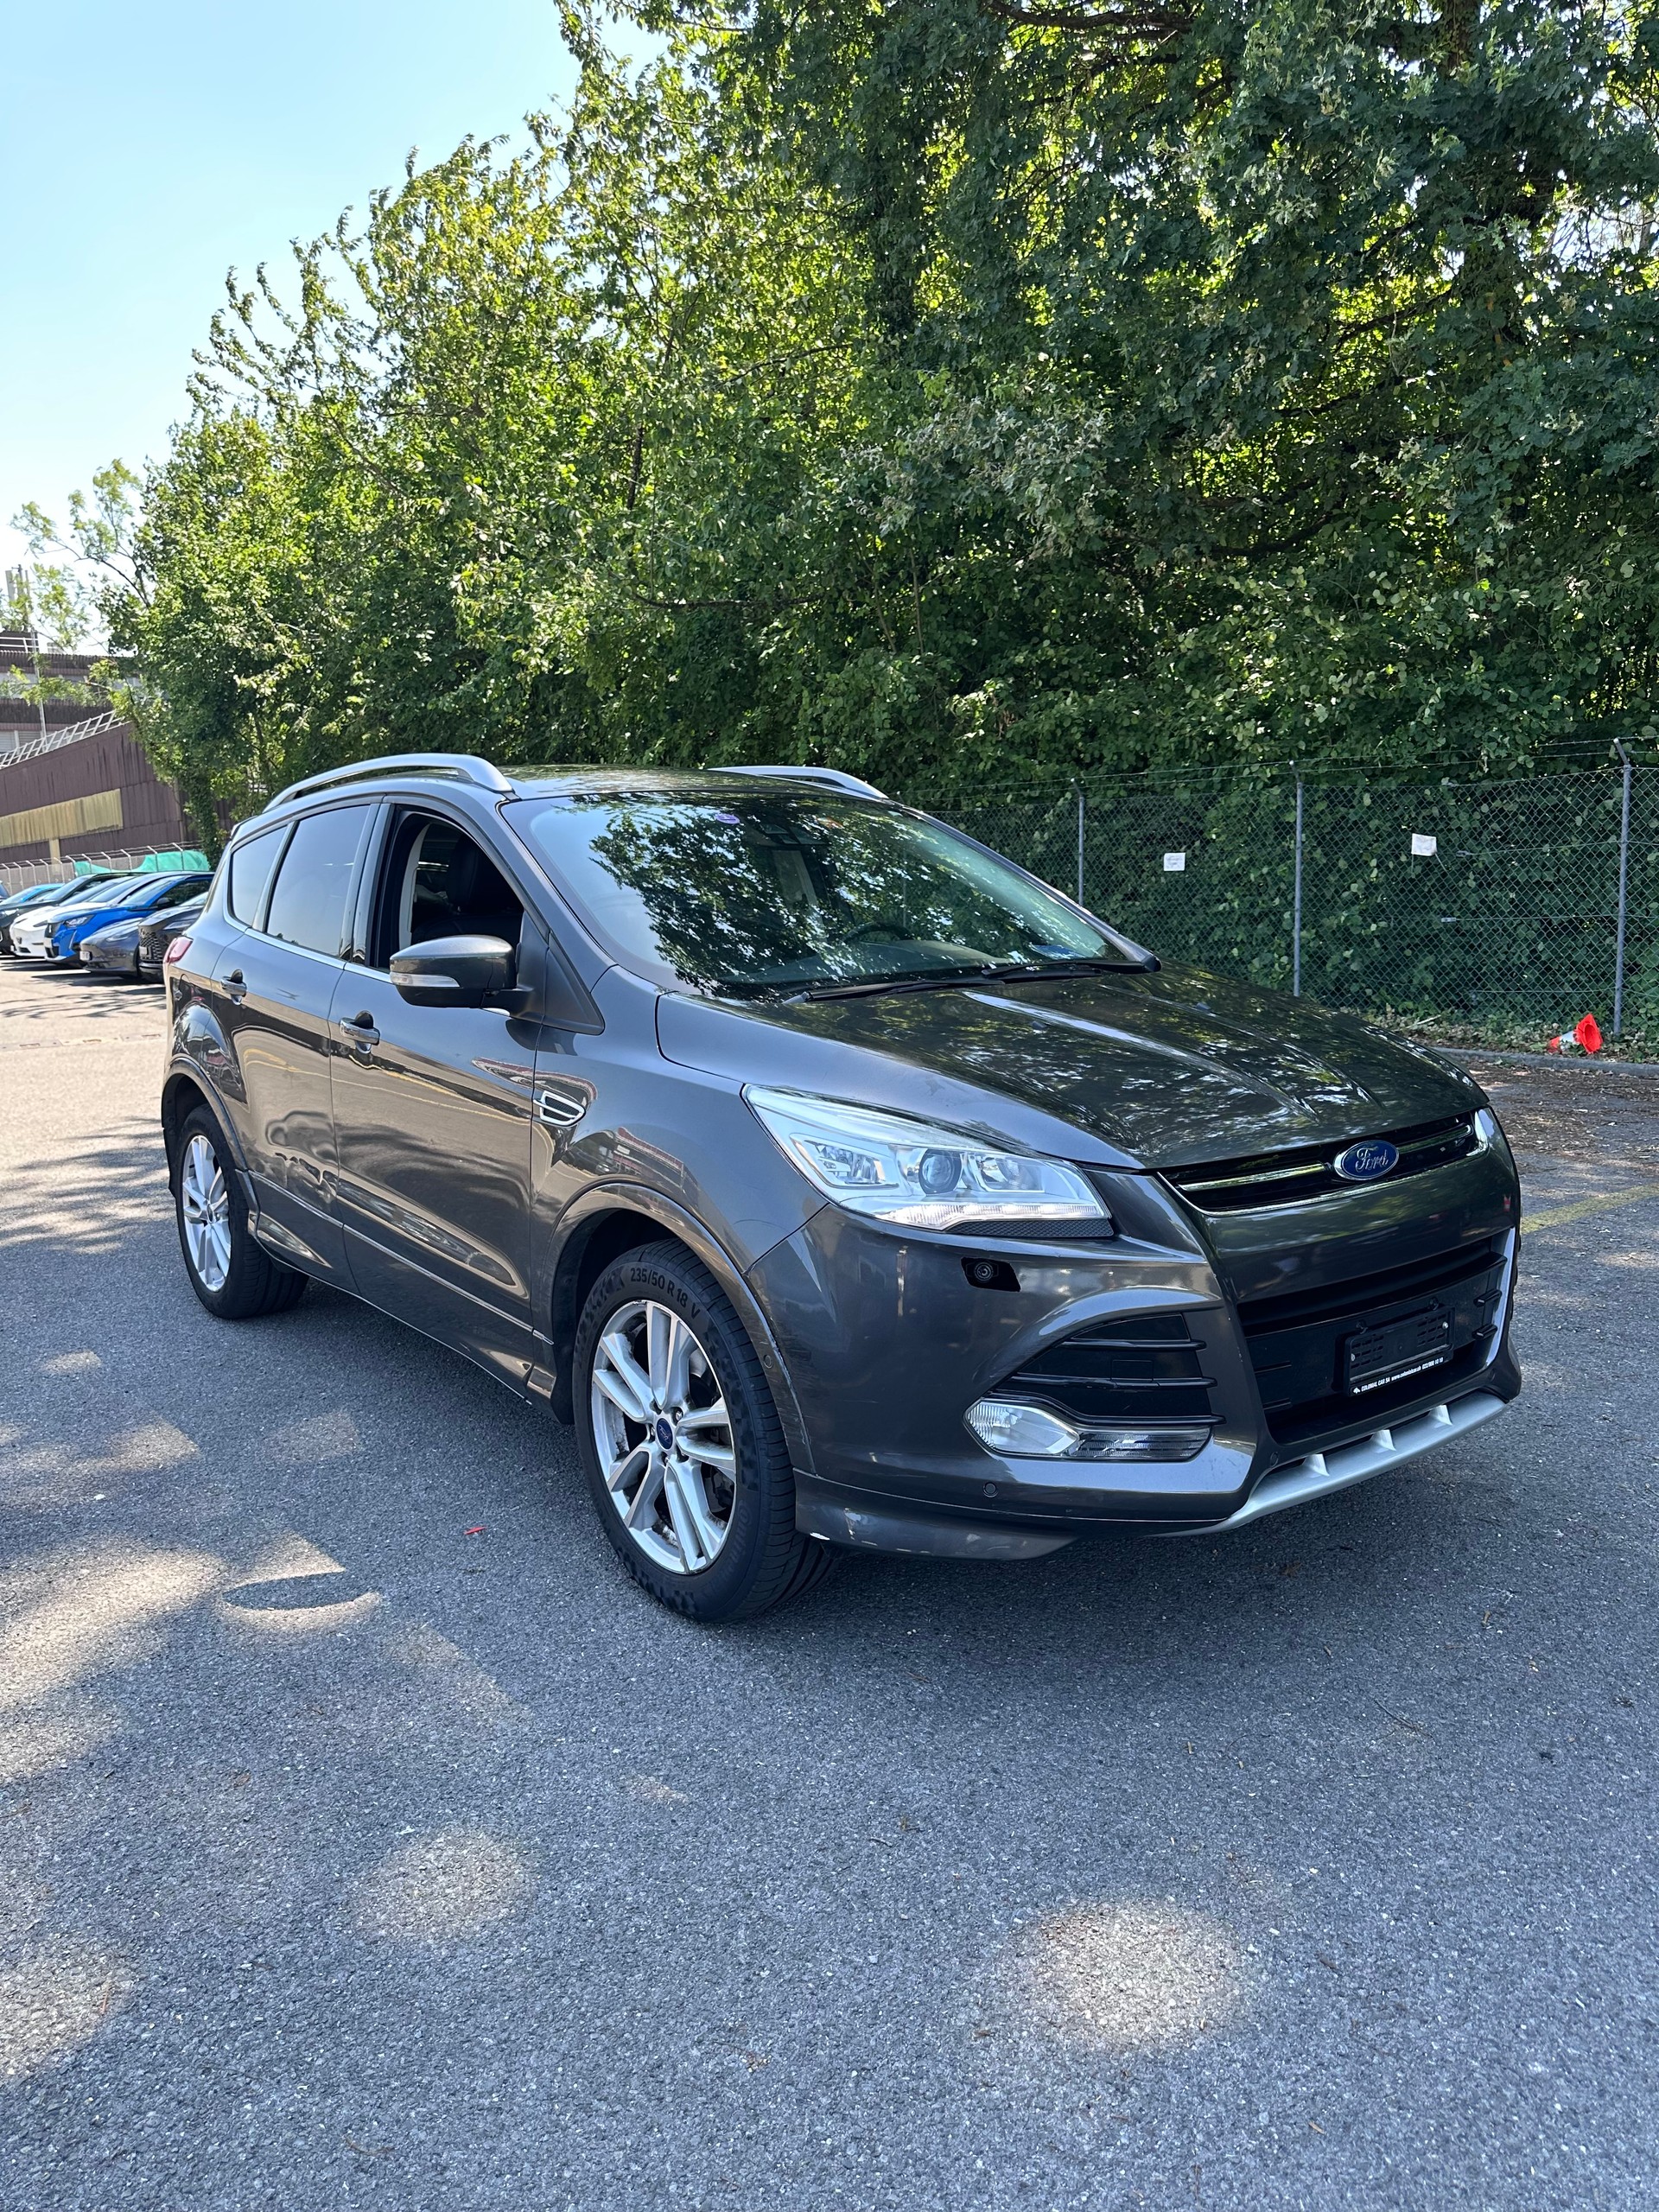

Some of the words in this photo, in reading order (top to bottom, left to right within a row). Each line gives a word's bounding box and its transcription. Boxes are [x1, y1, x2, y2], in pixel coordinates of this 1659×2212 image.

[1355, 1146, 1389, 1173] Ford
[630, 1267, 665, 1290] 235/50
[667, 1280, 675, 1297] R
[677, 1288, 688, 1307] 18
[690, 1302, 701, 1319] V
